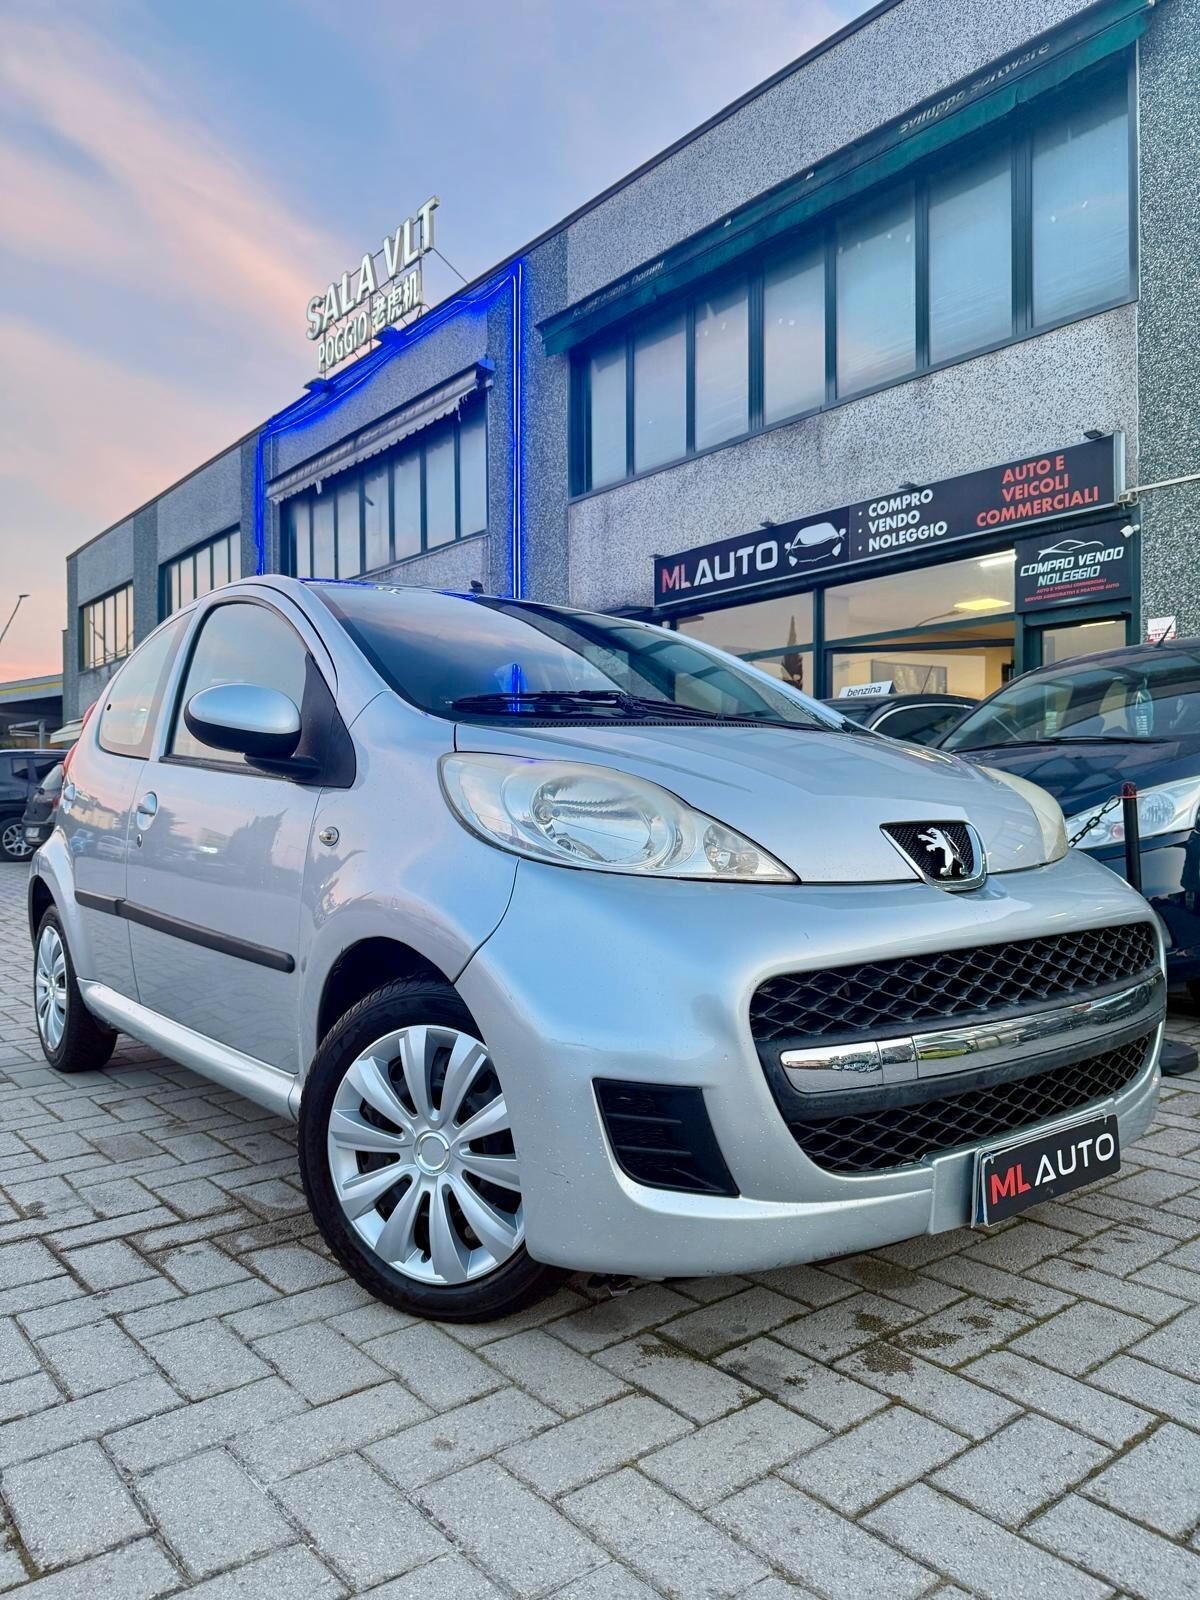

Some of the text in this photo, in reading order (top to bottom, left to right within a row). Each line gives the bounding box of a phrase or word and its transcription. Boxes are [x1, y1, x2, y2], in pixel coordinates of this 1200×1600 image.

[306, 195, 440, 341] SALA VLT
[372, 269, 423, 332] 老虎机
[318, 311, 372, 374] POGGIO
[1001, 454, 1065, 485] AUTO E
[868, 488, 934, 518] COMPRO
[1001, 473, 1070, 503] VEICOLI
[868, 509, 921, 535] VENDO
[975, 485, 1100, 528] COMMERCIALI
[868, 520, 949, 553] NOLEGGIO
[693, 540, 779, 587] AUTO
[1020, 546, 1125, 577] COMPRO VENDO
[1037, 565, 1101, 587] NOLEGGIO
[847, 685, 882, 697] benzina
[990, 1132, 1115, 1205] ML AUTO
